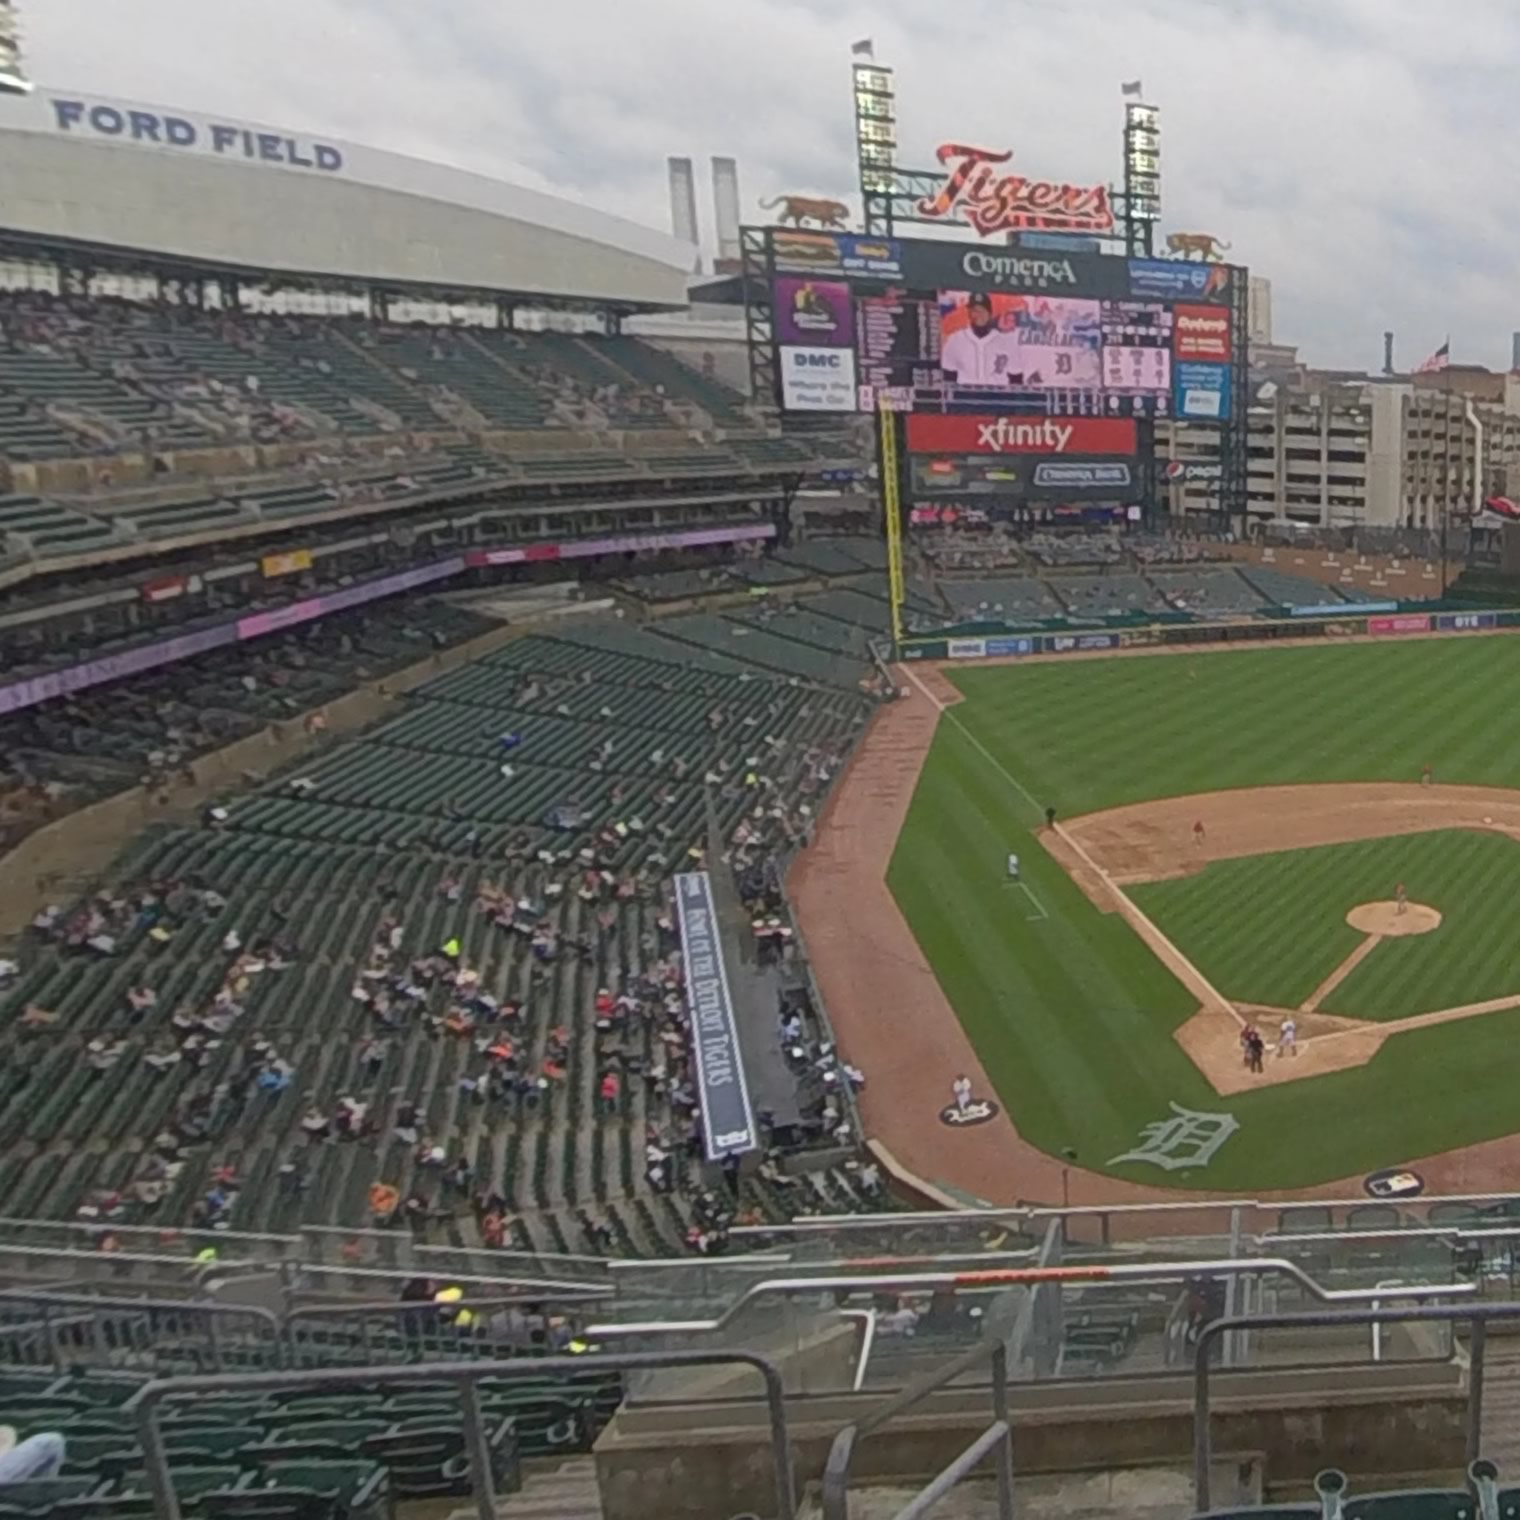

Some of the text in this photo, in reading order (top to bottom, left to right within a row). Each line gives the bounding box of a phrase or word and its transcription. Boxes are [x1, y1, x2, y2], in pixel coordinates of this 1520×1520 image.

[52, 99, 345, 172] FORD FIELD
[916, 143, 1114, 237] Tigers
[793, 352, 841, 368] DMC
[976, 418, 1074, 452] xfinity
[1184, 464, 1223, 479] pepsi
[692, 955, 715, 976] THE
[694, 978, 726, 1031] DETROIT
[702, 1033, 734, 1086] TIGERS
